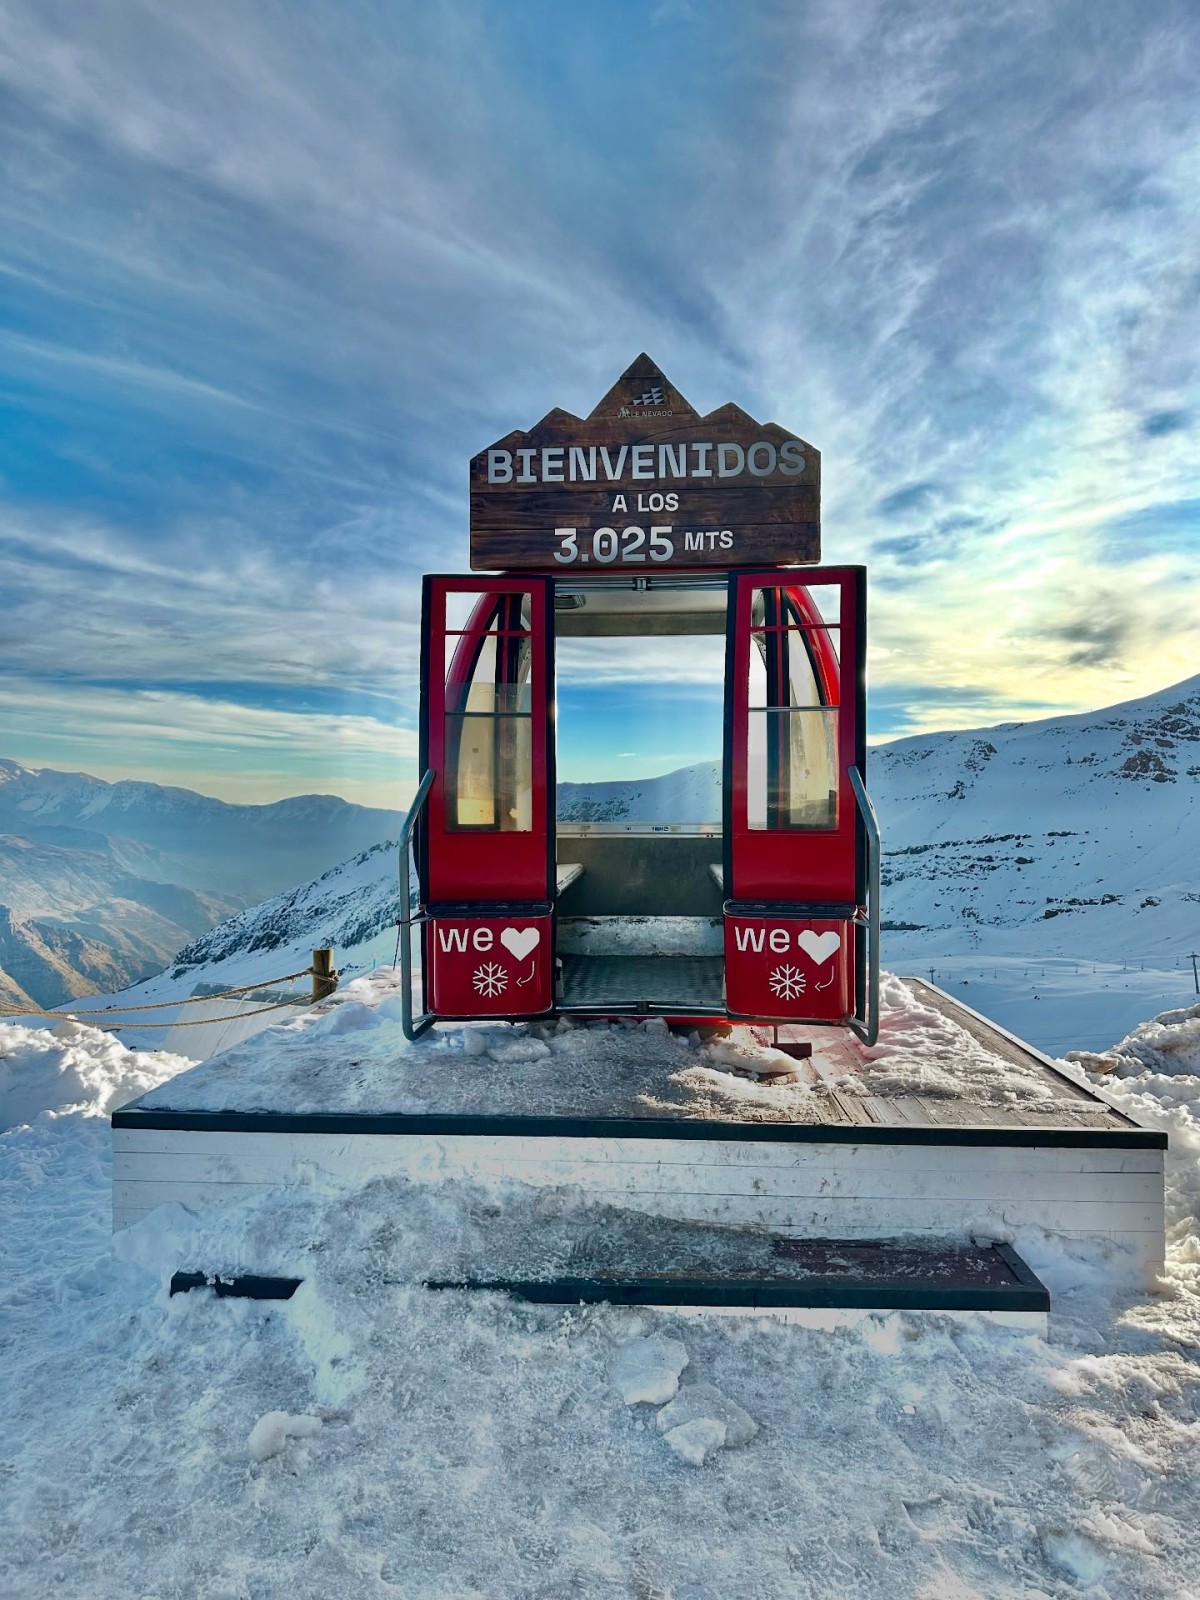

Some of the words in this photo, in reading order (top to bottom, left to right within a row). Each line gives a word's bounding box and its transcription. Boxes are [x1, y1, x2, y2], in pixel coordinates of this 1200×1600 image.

[487, 440, 806, 484] BIENVENIDOS
[612, 494, 628, 512] A
[637, 493, 679, 512] LOS
[552, 525, 674, 564] 3.025
[684, 530, 733, 551] MTS
[438, 927, 493, 952] we
[735, 926, 790, 953] we
